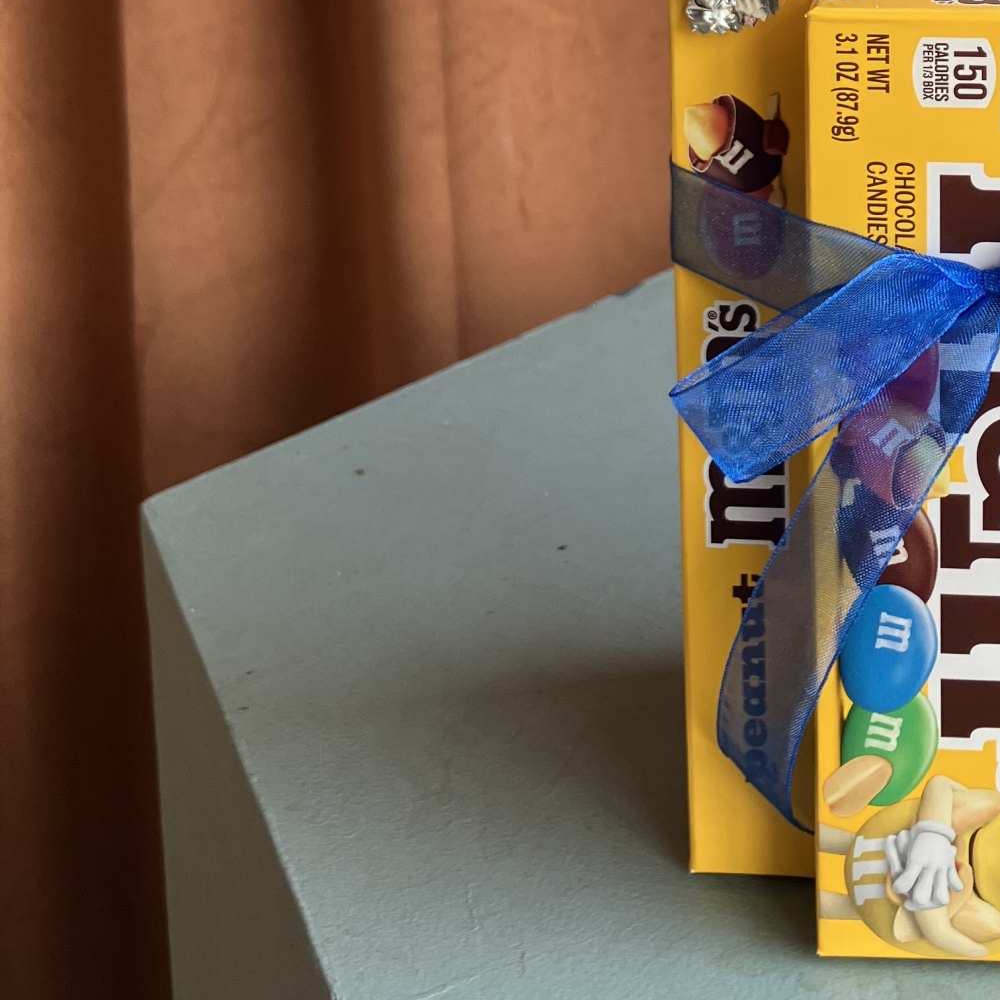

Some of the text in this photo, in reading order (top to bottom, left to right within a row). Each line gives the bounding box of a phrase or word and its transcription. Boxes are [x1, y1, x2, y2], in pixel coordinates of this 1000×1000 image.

[831, 32, 860, 143] 3.1 OZ (87.9g)
[866, 33, 891, 94] NET WT
[923, 43, 935, 100] PER 1/3 BOX
[934, 42, 950, 102] CALORIES
[953, 45, 988, 100] 150
